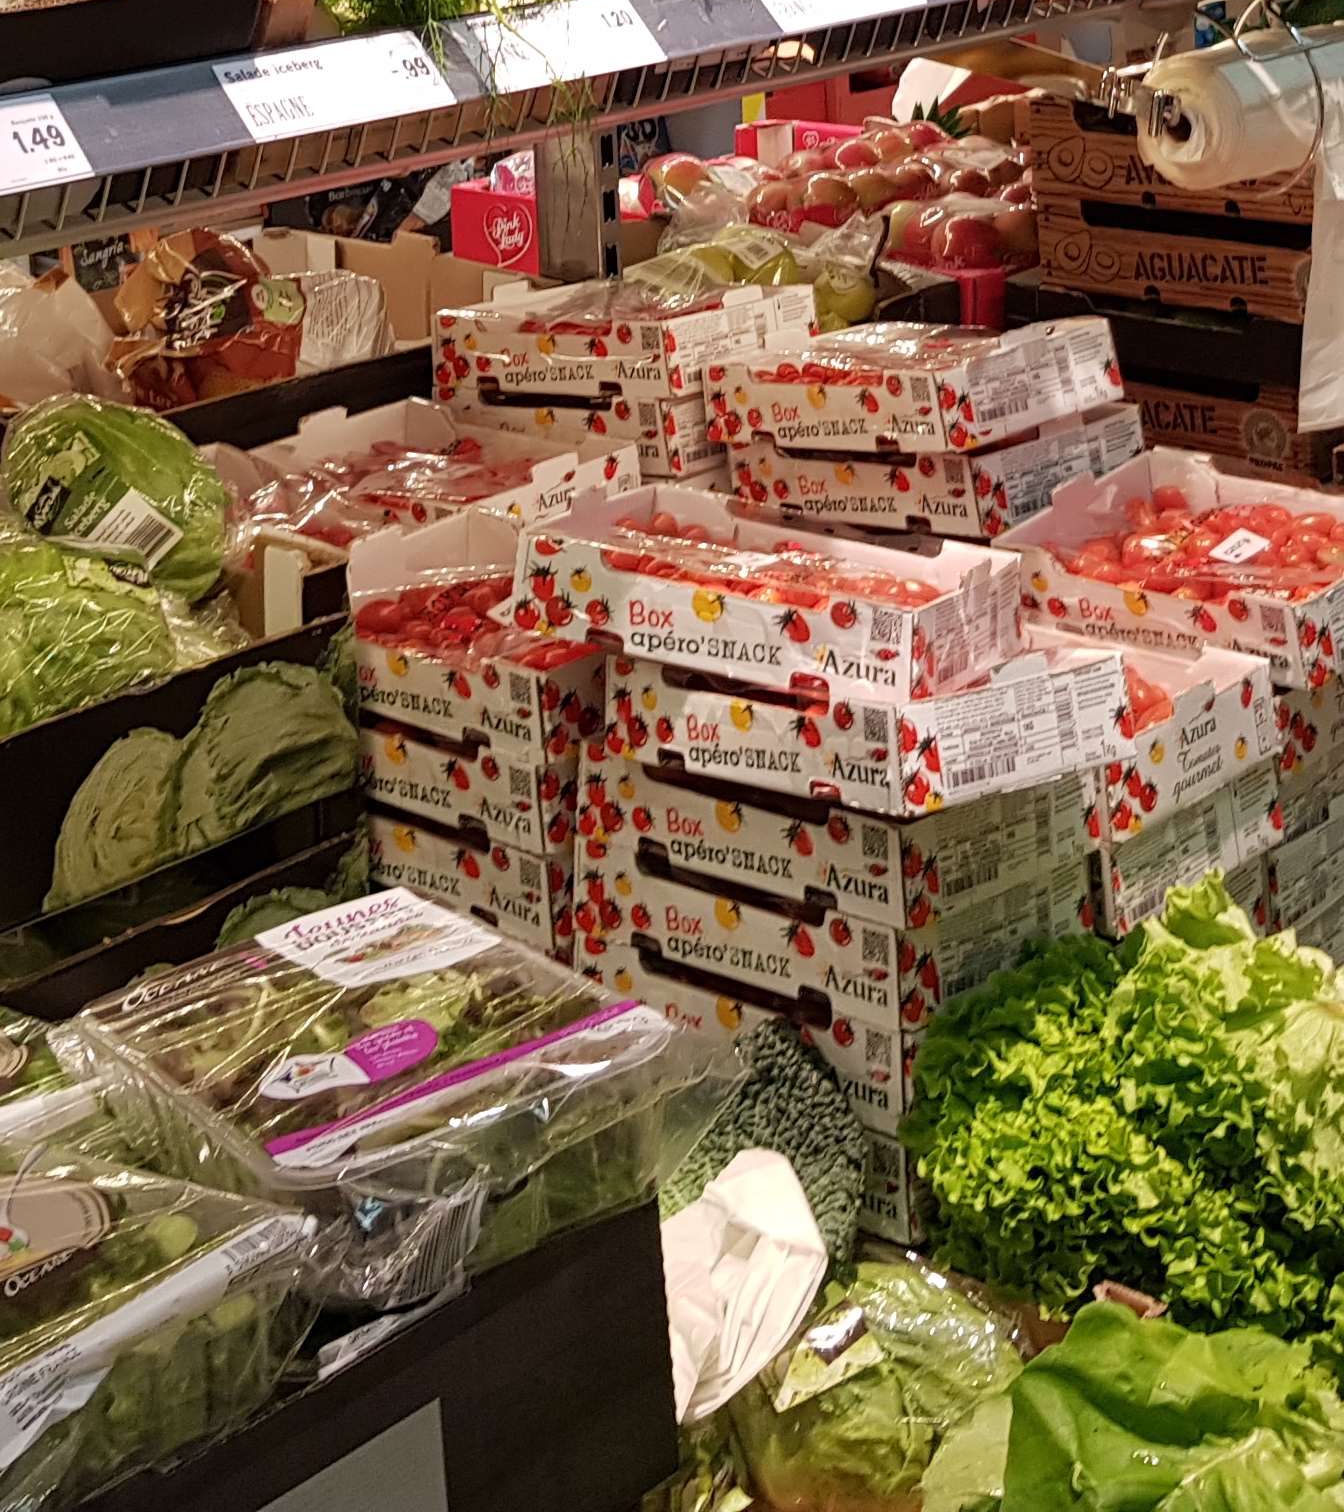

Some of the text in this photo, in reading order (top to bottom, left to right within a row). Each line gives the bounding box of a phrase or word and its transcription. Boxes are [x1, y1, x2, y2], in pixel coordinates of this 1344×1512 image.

[224, 58, 324, 85] Salade iceberg
[246, 95, 315, 129] ESPAGNE
[12, 124, 66, 155] 1.49
[492, 216, 522, 239] Pink
[500, 229, 525, 251] Lady
[80, 240, 125, 269] Sangria
[1133, 254, 1268, 285] AGUACATE
[618, 360, 663, 383] Azura
[770, 401, 802, 424] Box
[890, 412, 937, 438] Azura
[1140, 402, 1218, 435] ACATE
[797, 474, 827, 496] Box
[920, 494, 970, 518] Azura
[628, 599, 675, 629] Box
[1078, 597, 1114, 622] Box
[630, 629, 899, 688] apéro'SNACK Azura
[479, 707, 533, 744] Azura
[685, 712, 721, 743] Box
[1177, 717, 1218, 750] Azura
[688, 741, 893, 790] apéro'SNACK Azura
[1172, 758, 1225, 803] gourmet
[478, 799, 533, 837] Azura
[665, 807, 704, 838] Box
[669, 837, 891, 905] apéro'SNACK Azura
[487, 889, 542, 927] Azura
[664, 904, 702, 935] Box
[666, 935, 890, 1009] apéro'SNACK Azura
